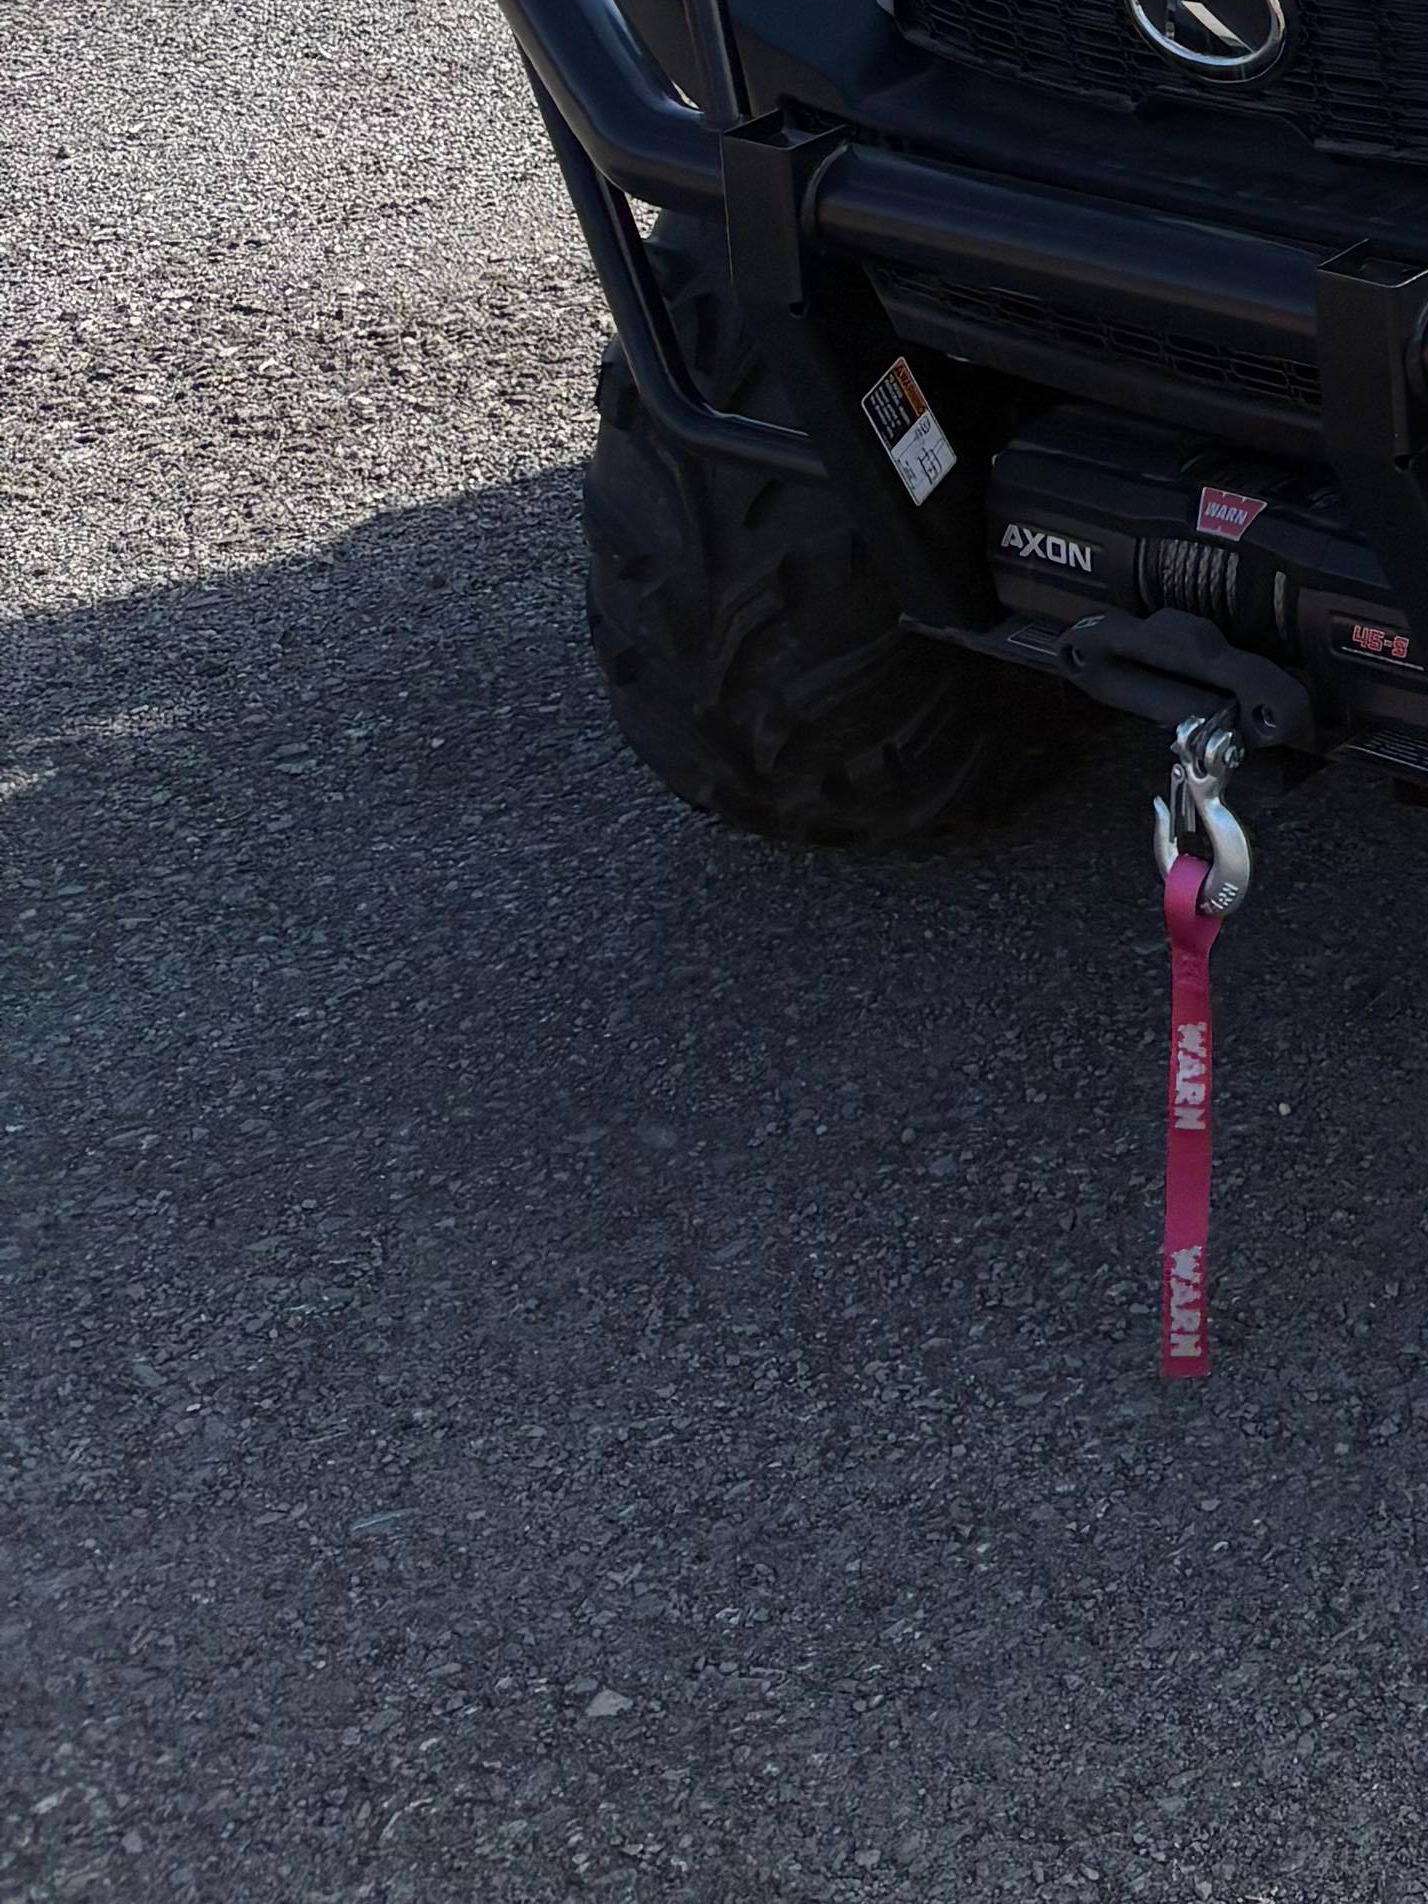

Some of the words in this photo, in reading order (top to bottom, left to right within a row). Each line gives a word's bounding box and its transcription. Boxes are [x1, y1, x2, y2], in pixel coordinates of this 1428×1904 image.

[1000, 523, 1092, 573] AXON
[1204, 501, 1248, 526] WARN
[1174, 1021, 1208, 1130] WARN
[1168, 1245, 1203, 1357] WARN
